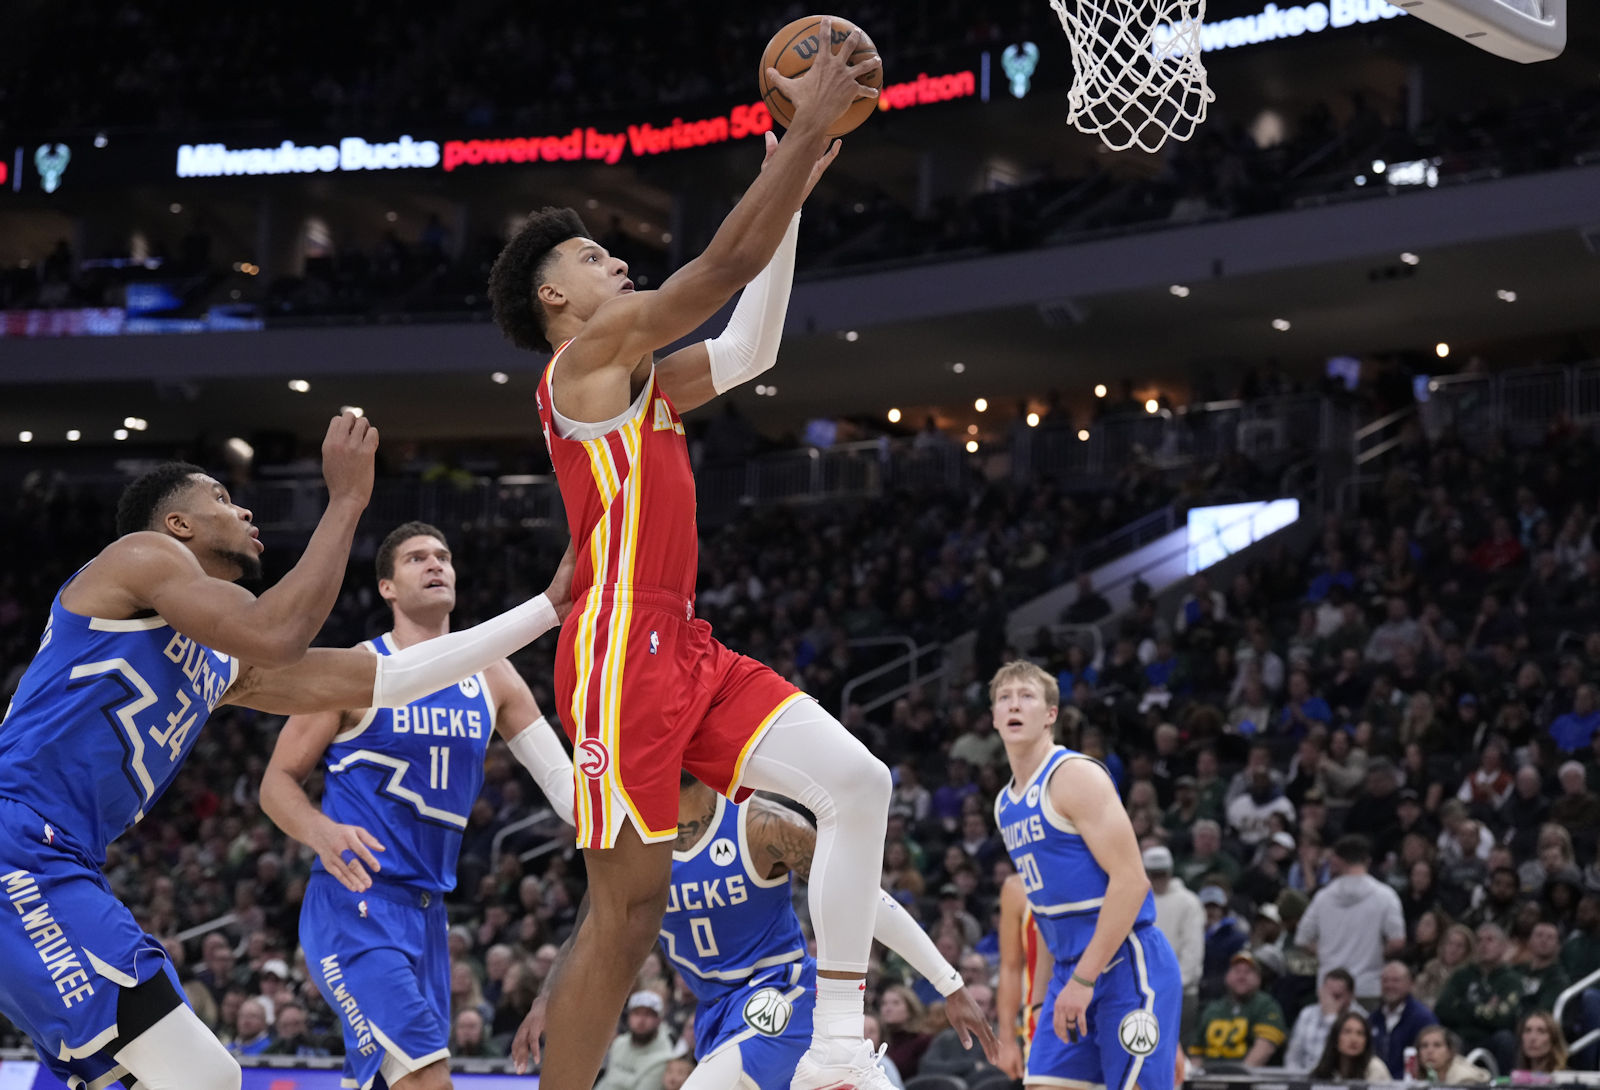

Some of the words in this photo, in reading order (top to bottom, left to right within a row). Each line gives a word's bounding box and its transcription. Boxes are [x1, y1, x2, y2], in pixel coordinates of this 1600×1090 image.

[1330, 0, 1407, 28] Buc
[176, 139, 340, 178] Milwaukee
[340, 134, 440, 171] Bucks
[443, 127, 584, 171] powered
[584, 126, 626, 165] by
[627, 115, 729, 157] Verizon
[729, 101, 774, 140] 5G
[148, 688, 198, 762] 34
[392, 706, 482, 739] BUCKS
[429, 746, 450, 790] 11
[665, 874, 748, 913] UCKS
[0, 869, 95, 1009] MILWAUKEE
[689, 917, 719, 957] 0
[320, 953, 377, 1057] MILWAUKEE
